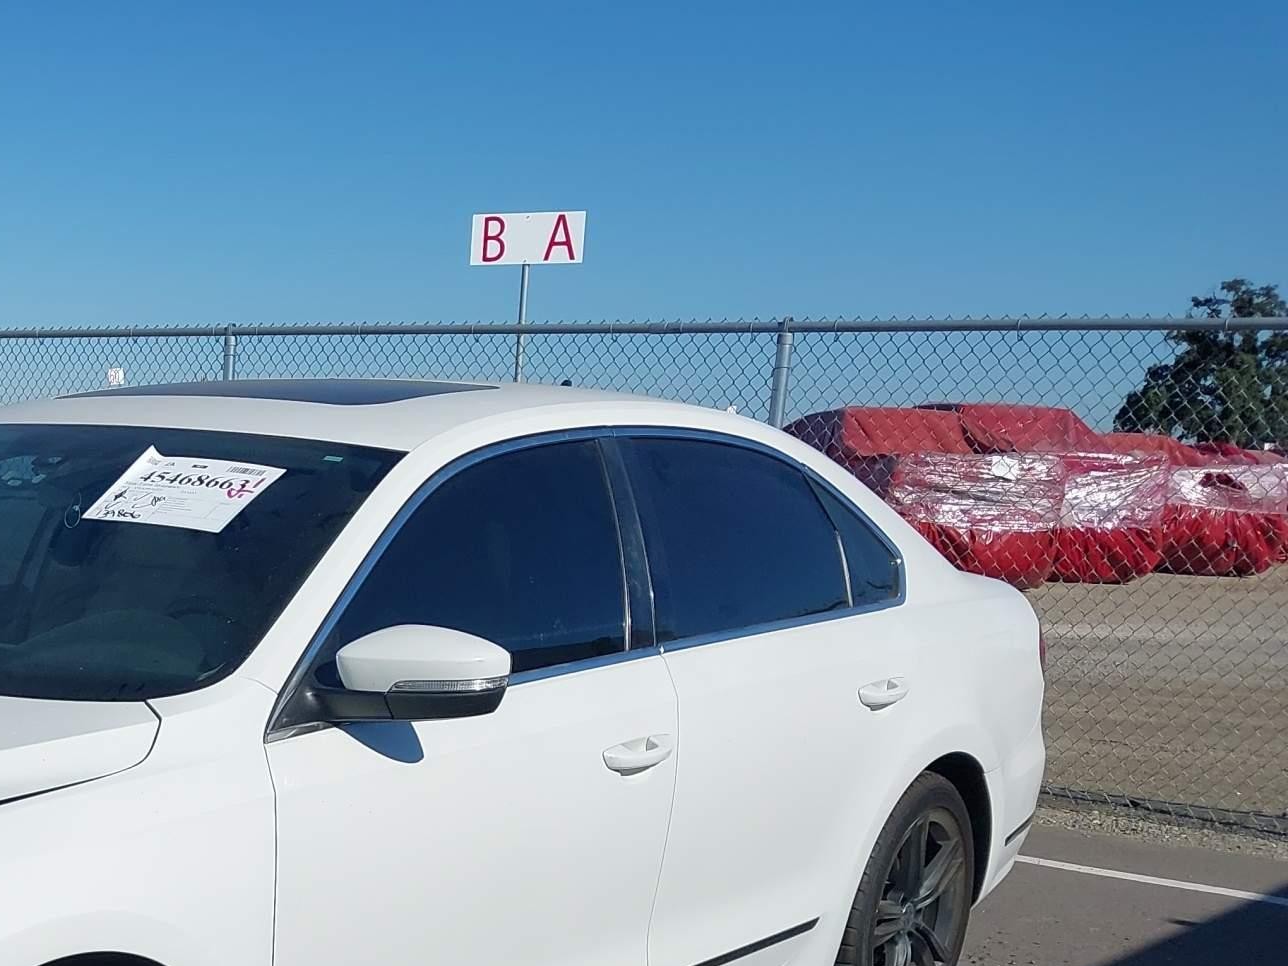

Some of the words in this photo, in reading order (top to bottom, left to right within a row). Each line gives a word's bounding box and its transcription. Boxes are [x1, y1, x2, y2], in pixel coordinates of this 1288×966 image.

[481, 216, 506, 262] B
[543, 213, 575, 262] A
[140, 470, 251, 492] 45468663
